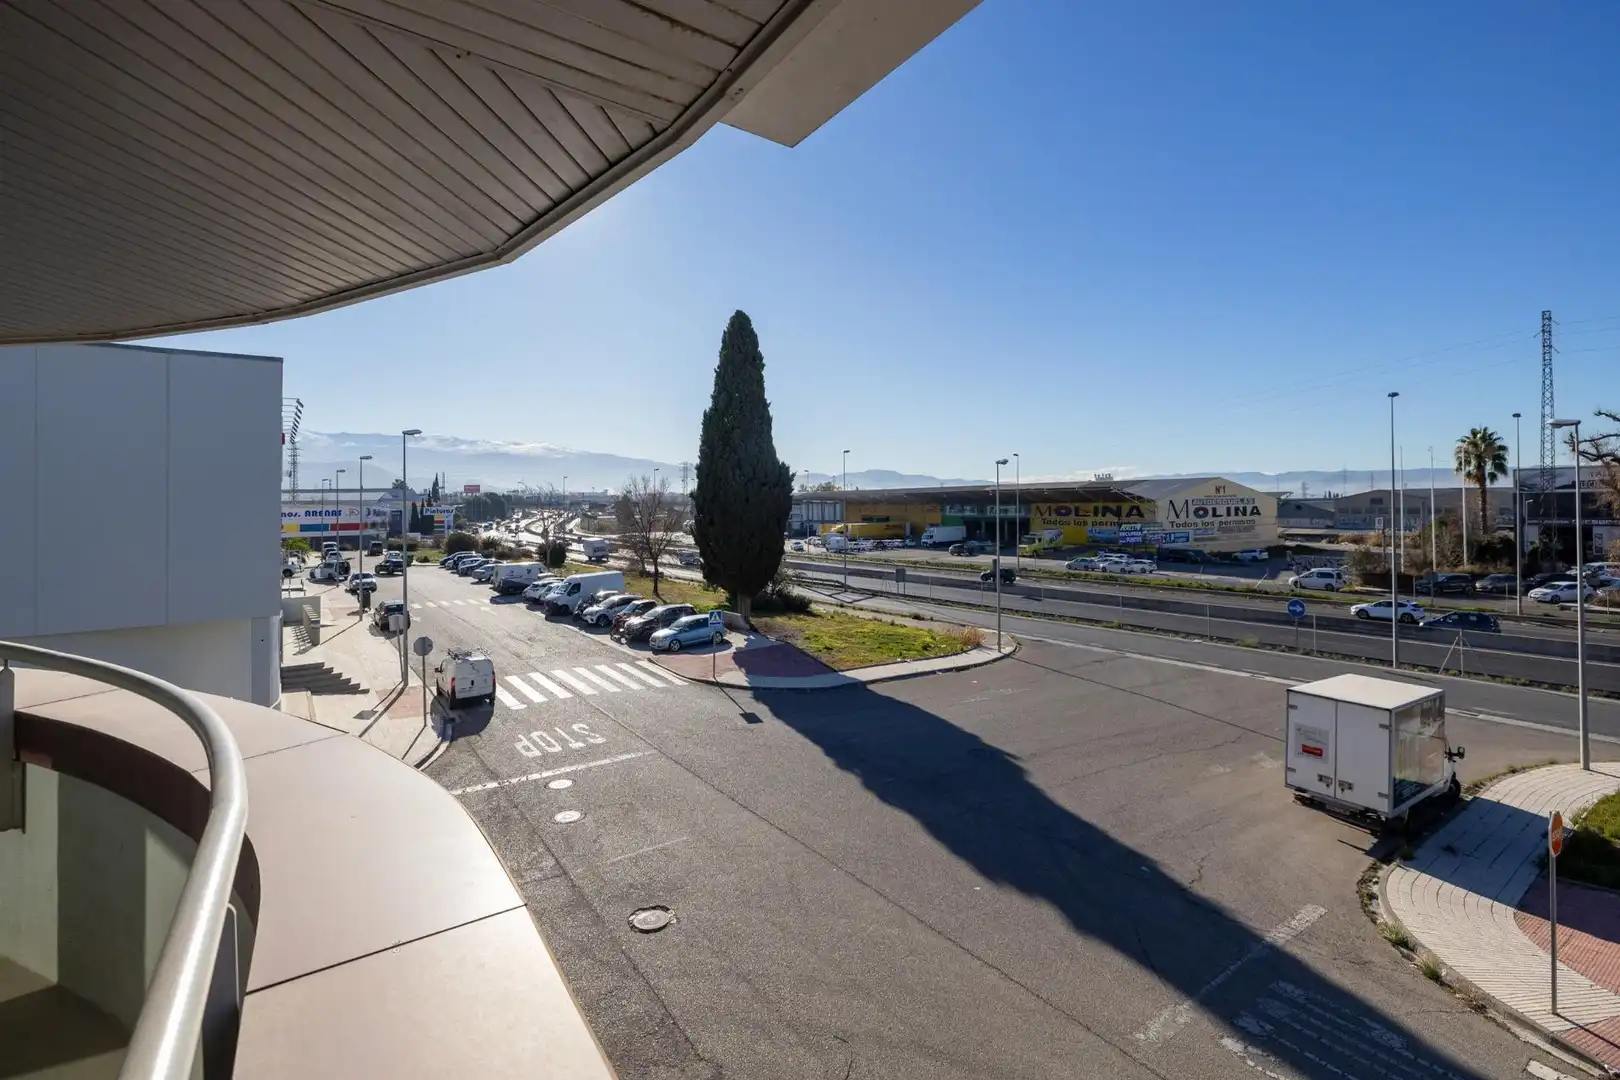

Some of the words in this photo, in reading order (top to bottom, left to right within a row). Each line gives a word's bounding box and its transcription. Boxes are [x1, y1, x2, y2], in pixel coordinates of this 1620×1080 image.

[304, 509, 342, 518] ARENAS
[1033, 504, 1145, 518] MOLINA
[1166, 499, 1262, 520] MOLINA
[1041, 518, 1071, 527] Todos
[1073, 519, 1089, 527] los
[1170, 520, 1198, 529] Todos
[1201, 519, 1215, 528] los
[1218, 518, 1257, 528] permisos
[514, 723, 606, 758] STOP
